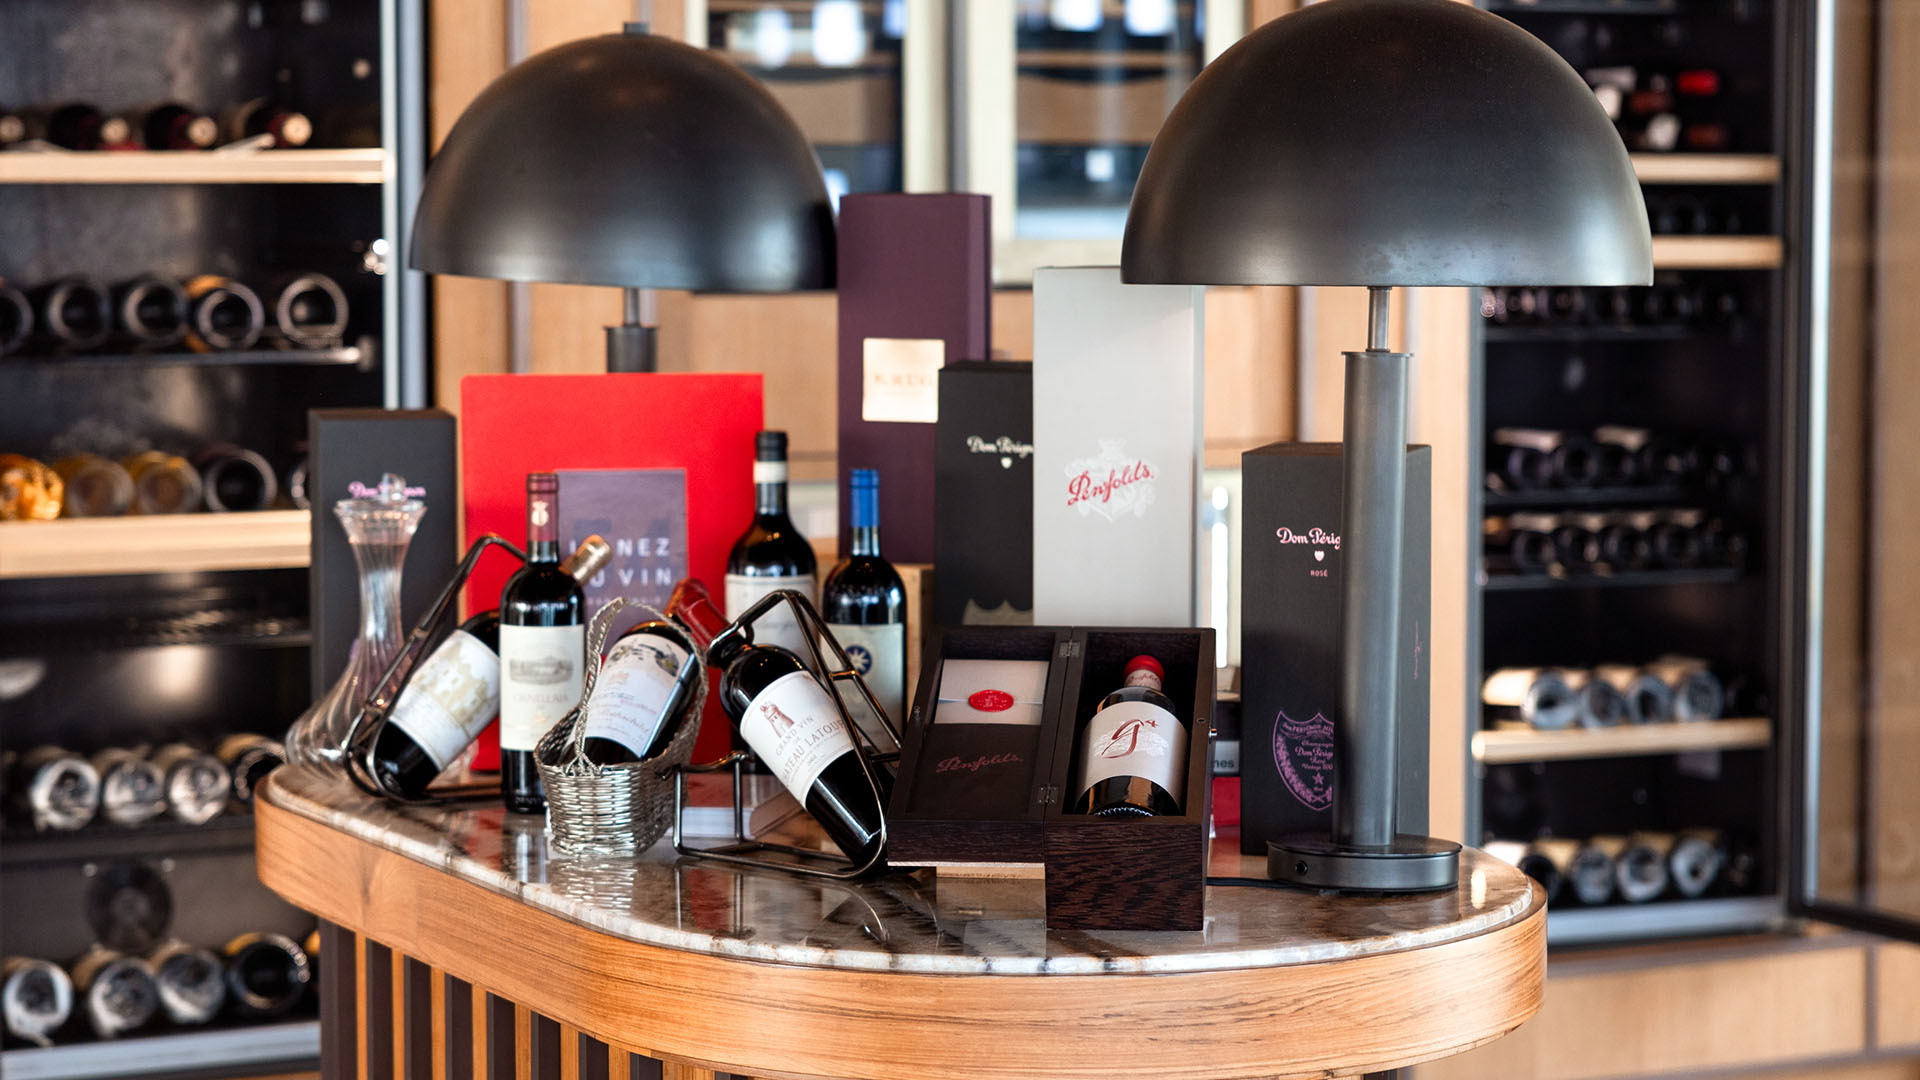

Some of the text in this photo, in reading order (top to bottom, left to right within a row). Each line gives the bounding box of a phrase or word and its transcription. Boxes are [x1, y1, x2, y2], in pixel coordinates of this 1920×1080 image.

[967, 435, 997, 453] Dom
[1276, 527, 1309, 544] Dom
[616, 537, 670, 557] NEZ
[618, 567, 672, 586] VIN
[775, 715, 814, 756] GRAND VIN
